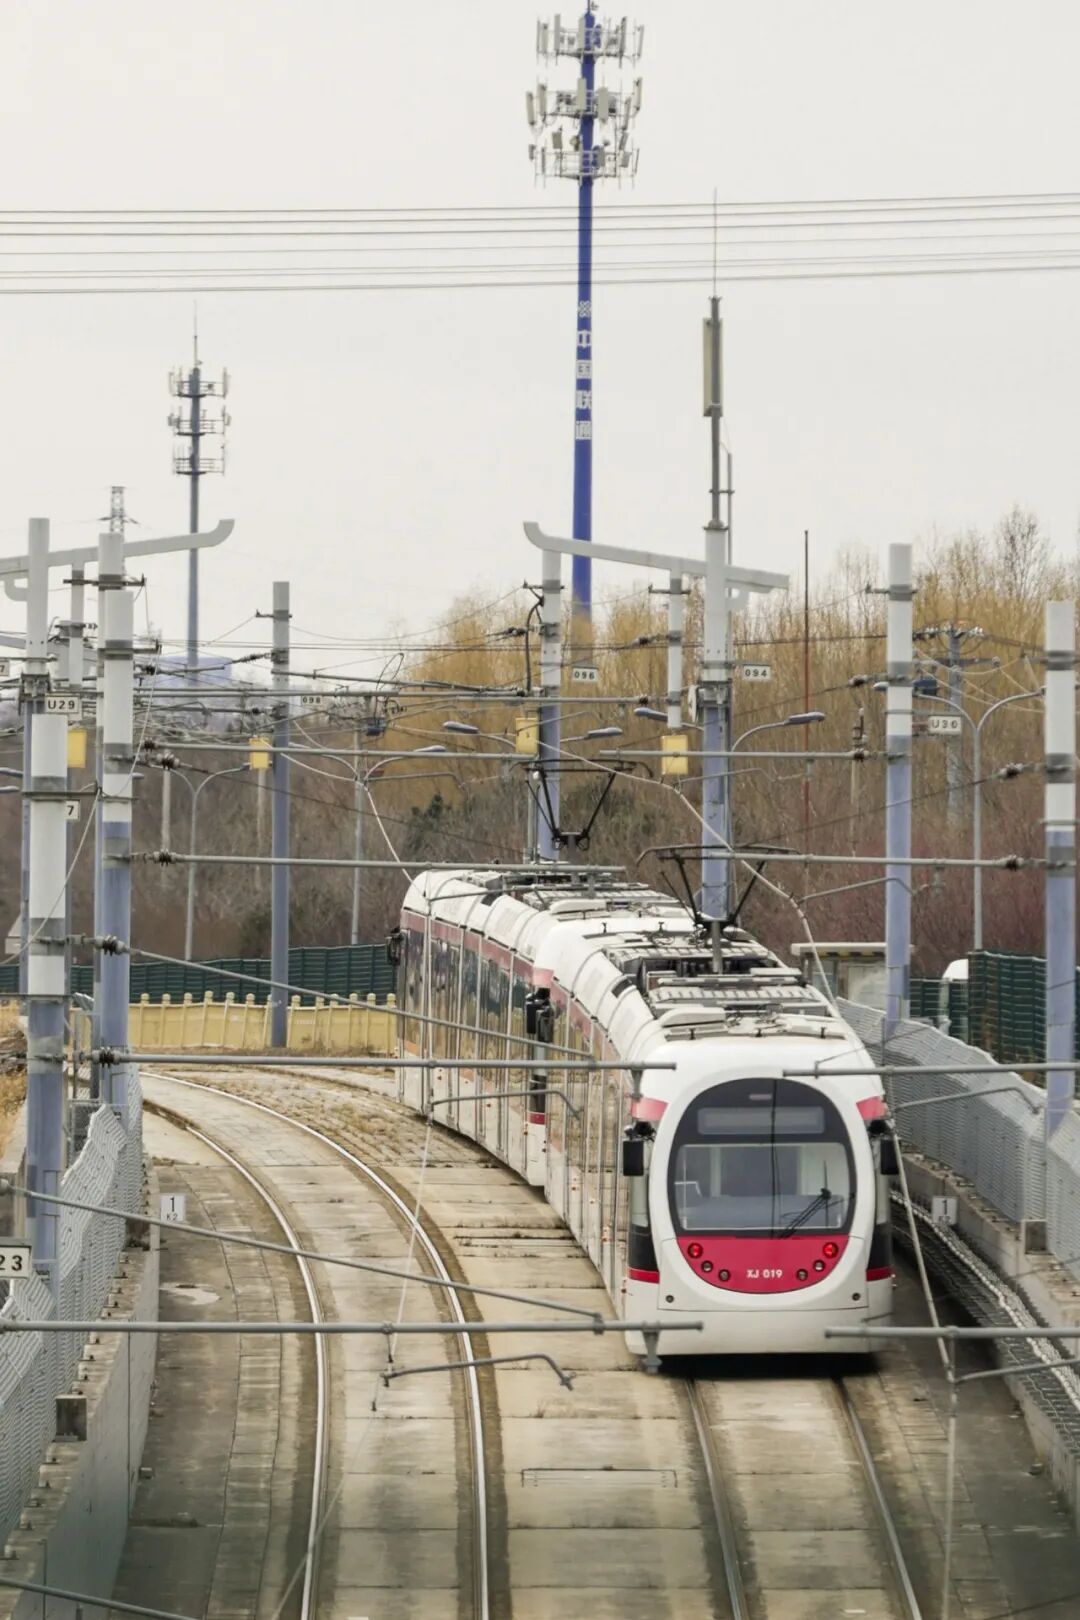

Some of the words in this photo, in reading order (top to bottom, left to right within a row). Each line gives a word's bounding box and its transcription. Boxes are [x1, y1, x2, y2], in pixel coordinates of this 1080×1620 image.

[47, 700, 75, 709] U29
[931, 719, 958, 729] U30
[66, 804, 75, 816] 7
[169, 1196, 175, 1213] 1
[746, 1269, 760, 1279] XJ
[762, 1269, 783, 1279] 019
